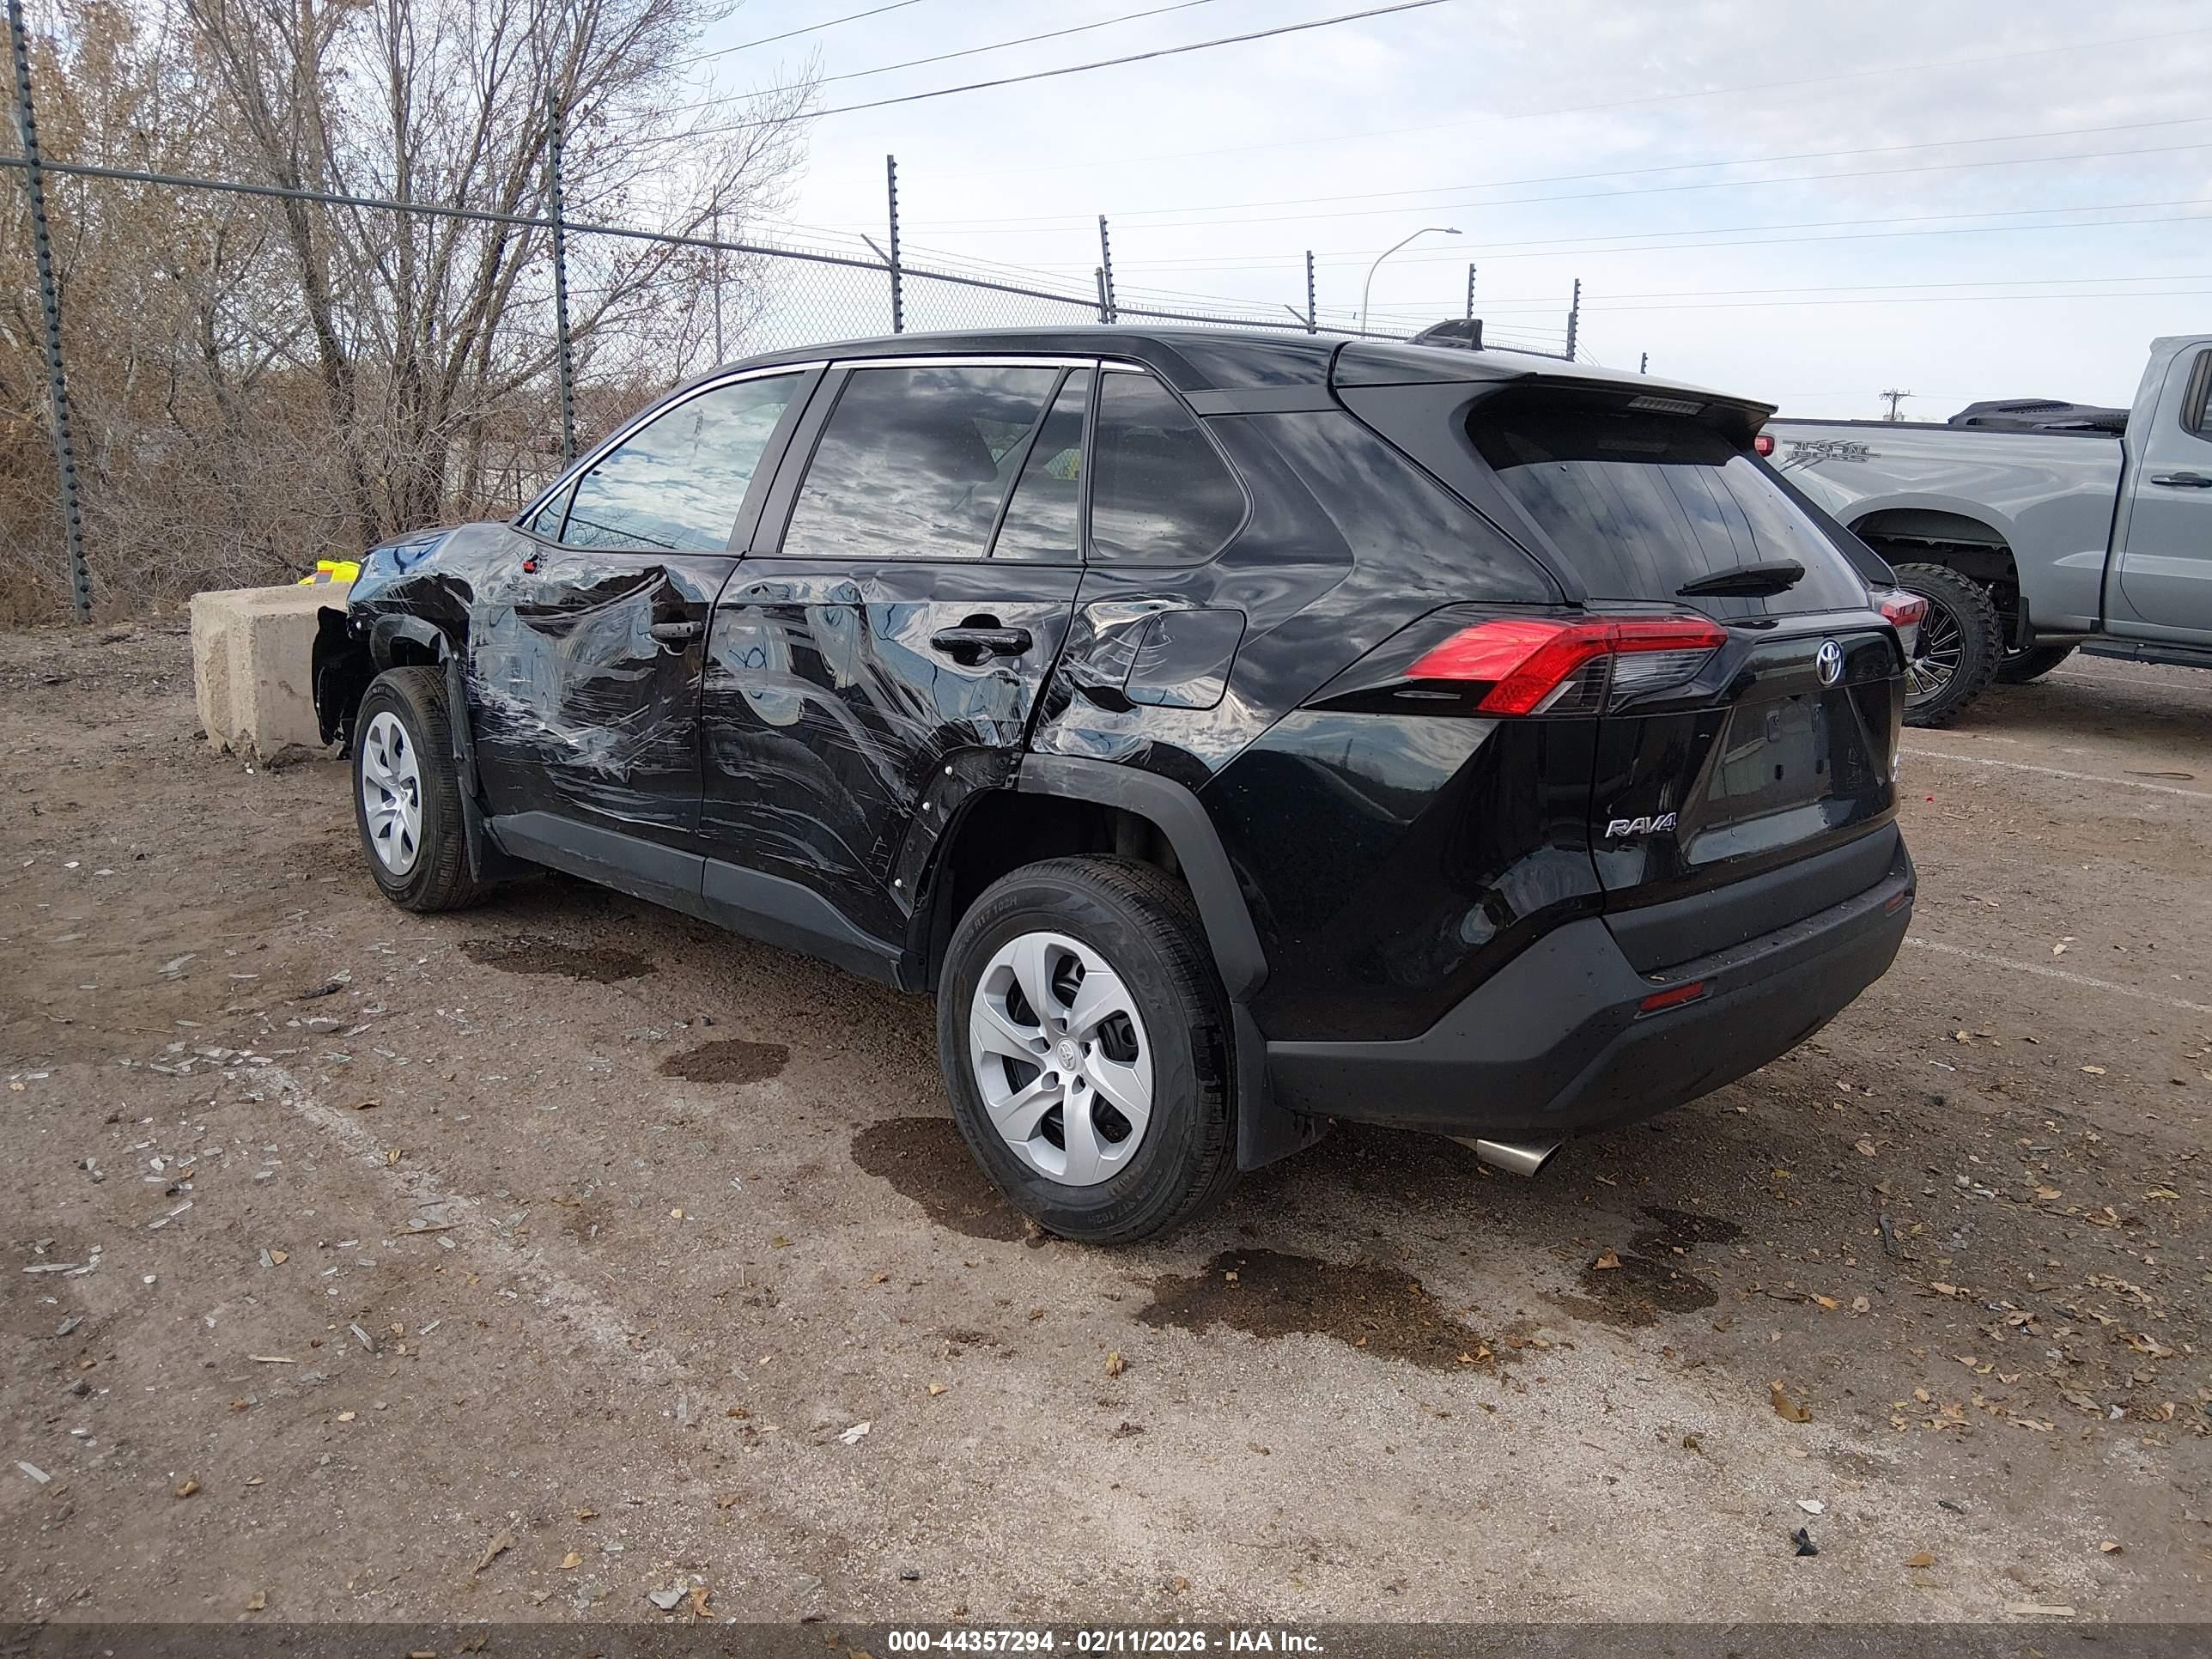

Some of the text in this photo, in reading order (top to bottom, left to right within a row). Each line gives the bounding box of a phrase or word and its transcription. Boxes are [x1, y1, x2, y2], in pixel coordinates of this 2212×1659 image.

[1783, 439, 1881, 459] TRAIL
[1793, 451, 1869, 464] BOSS
[1604, 811, 1677, 838] RAV4
